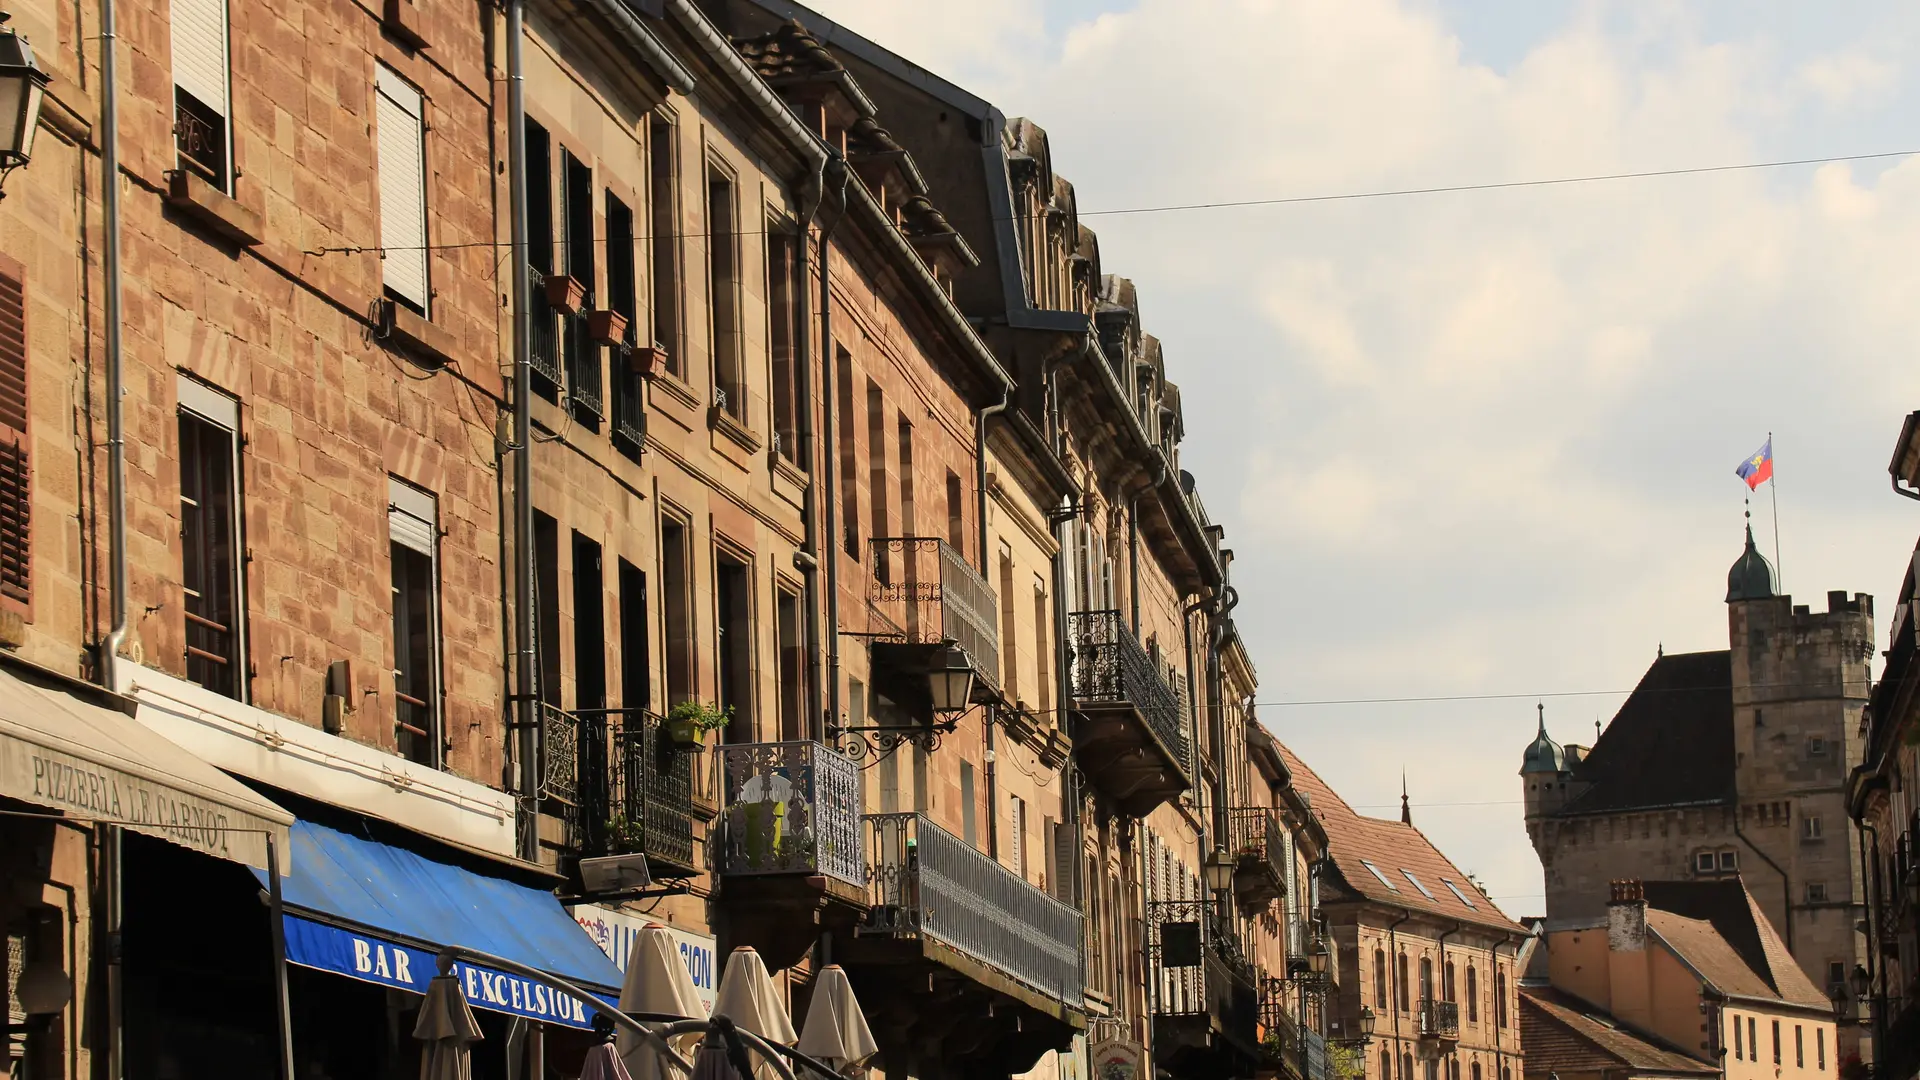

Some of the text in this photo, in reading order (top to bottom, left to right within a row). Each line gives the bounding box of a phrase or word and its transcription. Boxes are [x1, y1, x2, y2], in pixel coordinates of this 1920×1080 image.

[33, 756, 228, 851] PIZZERIA LE CARNOT
[352, 938, 414, 983] BAR
